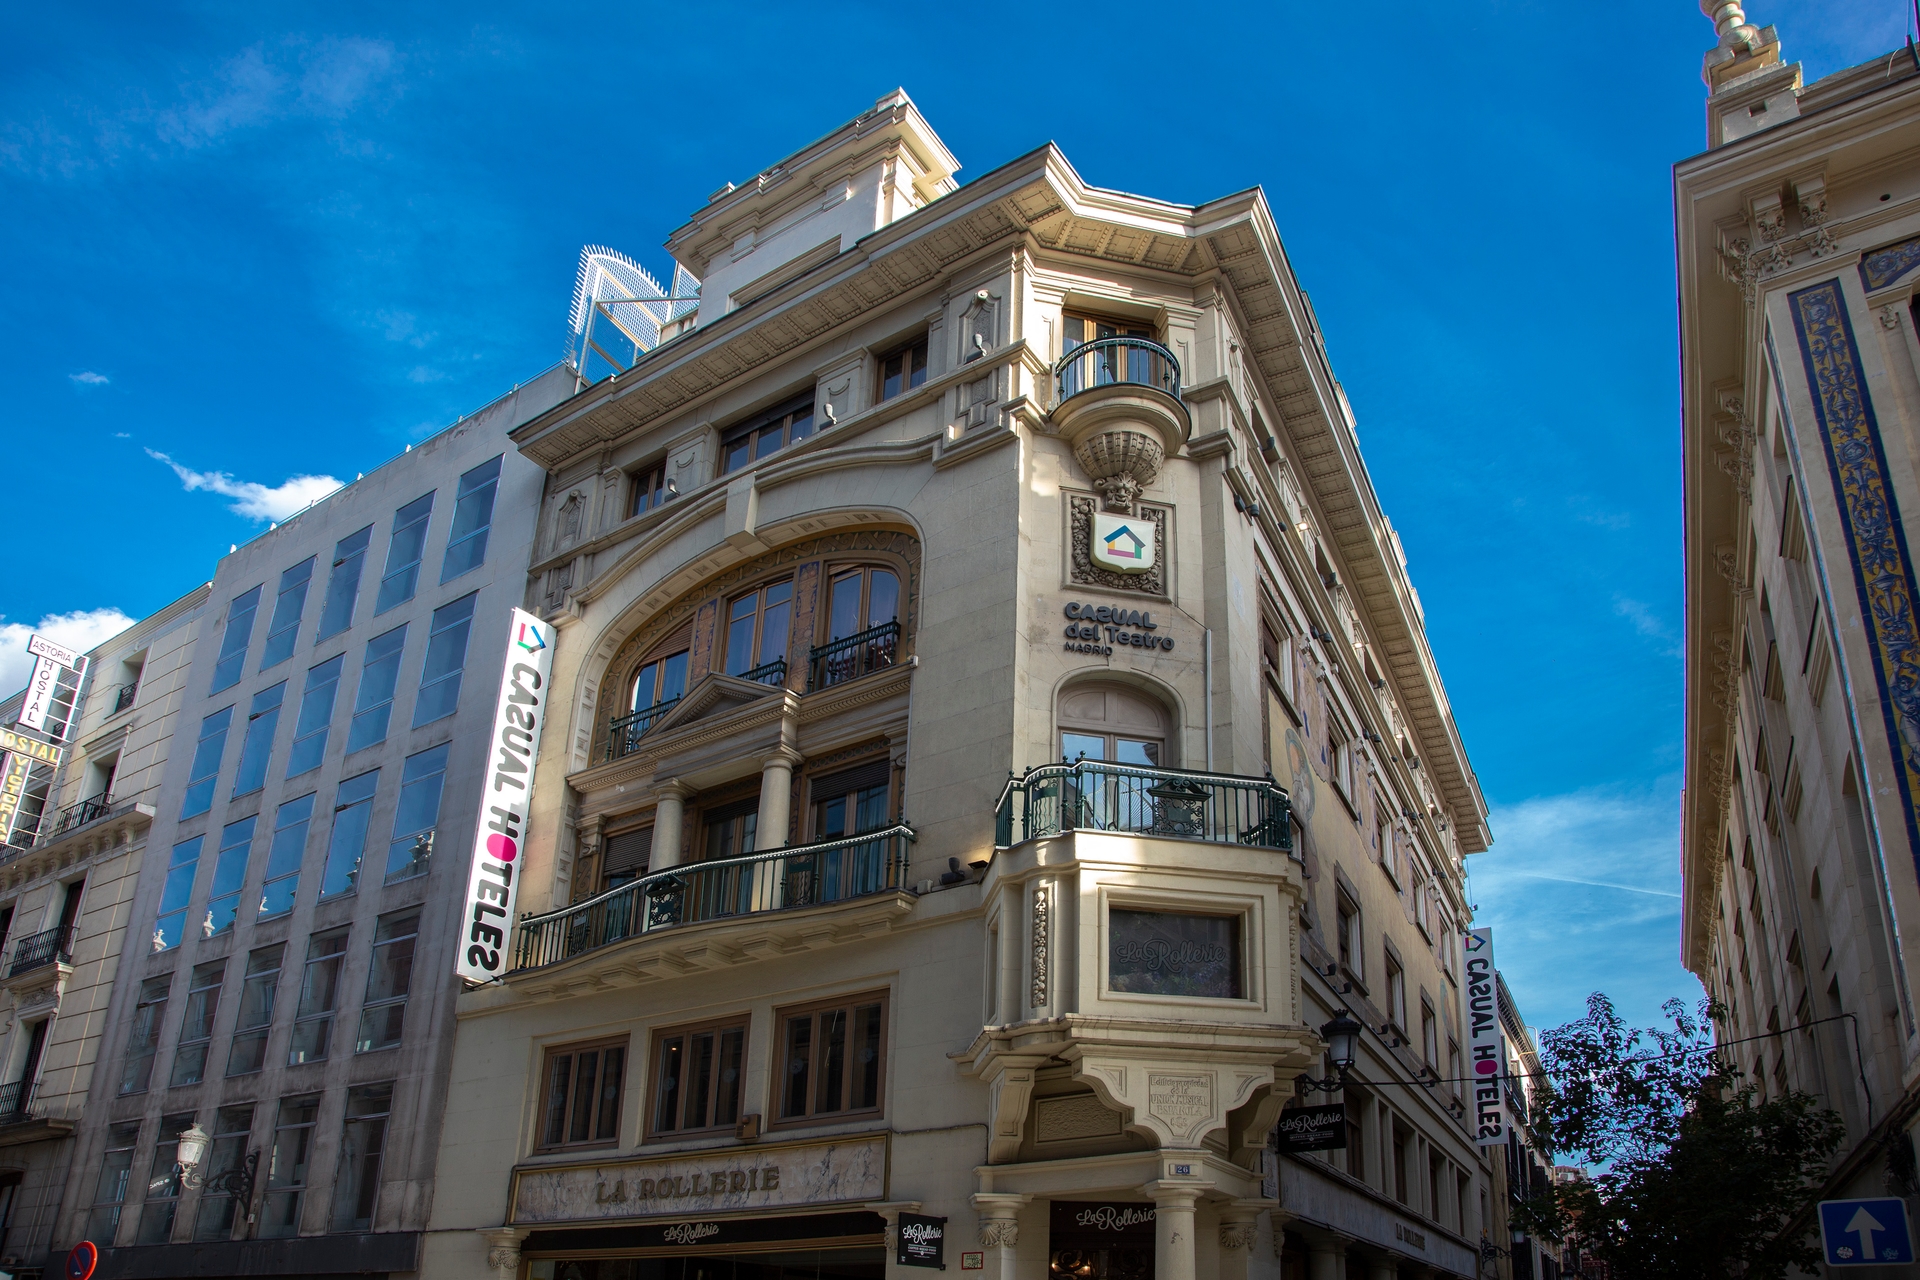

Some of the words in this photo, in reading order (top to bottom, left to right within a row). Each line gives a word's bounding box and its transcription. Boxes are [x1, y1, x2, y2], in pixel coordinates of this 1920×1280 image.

[1065, 602, 1157, 629] CASUAL
[1064, 641, 1113, 656] MADRID
[1065, 622, 1101, 641] del
[1105, 625, 1175, 651] Teatro
[32, 640, 72, 662] ASTORIA
[27, 659, 54, 723] HOSTAL
[494, 662, 542, 792] CASUAL
[467, 805, 521, 972] HOTELES
[1115, 941, 1145, 964] La
[1141, 938, 1227, 973] Rollerie
[1466, 958, 1494, 1039] CASUAL
[1473, 1044, 1502, 1138] HOTELES
[1280, 1119, 1296, 1131] La
[1295, 1113, 1342, 1132] Rollerie
[1177, 1165, 1189, 1173] 26
[595, 1180, 627, 1203] LA
[638, 1166, 780, 1200] ROLLERIE
[1075, 1209, 1096, 1227] La
[1095, 1206, 1156, 1231] Rollerie
[1396, 1223, 1403, 1241] LA
[663, 1226, 677, 1241] La
[676, 1223, 720, 1244] Rollerie
[912, 1223, 942, 1245] Rollerie
